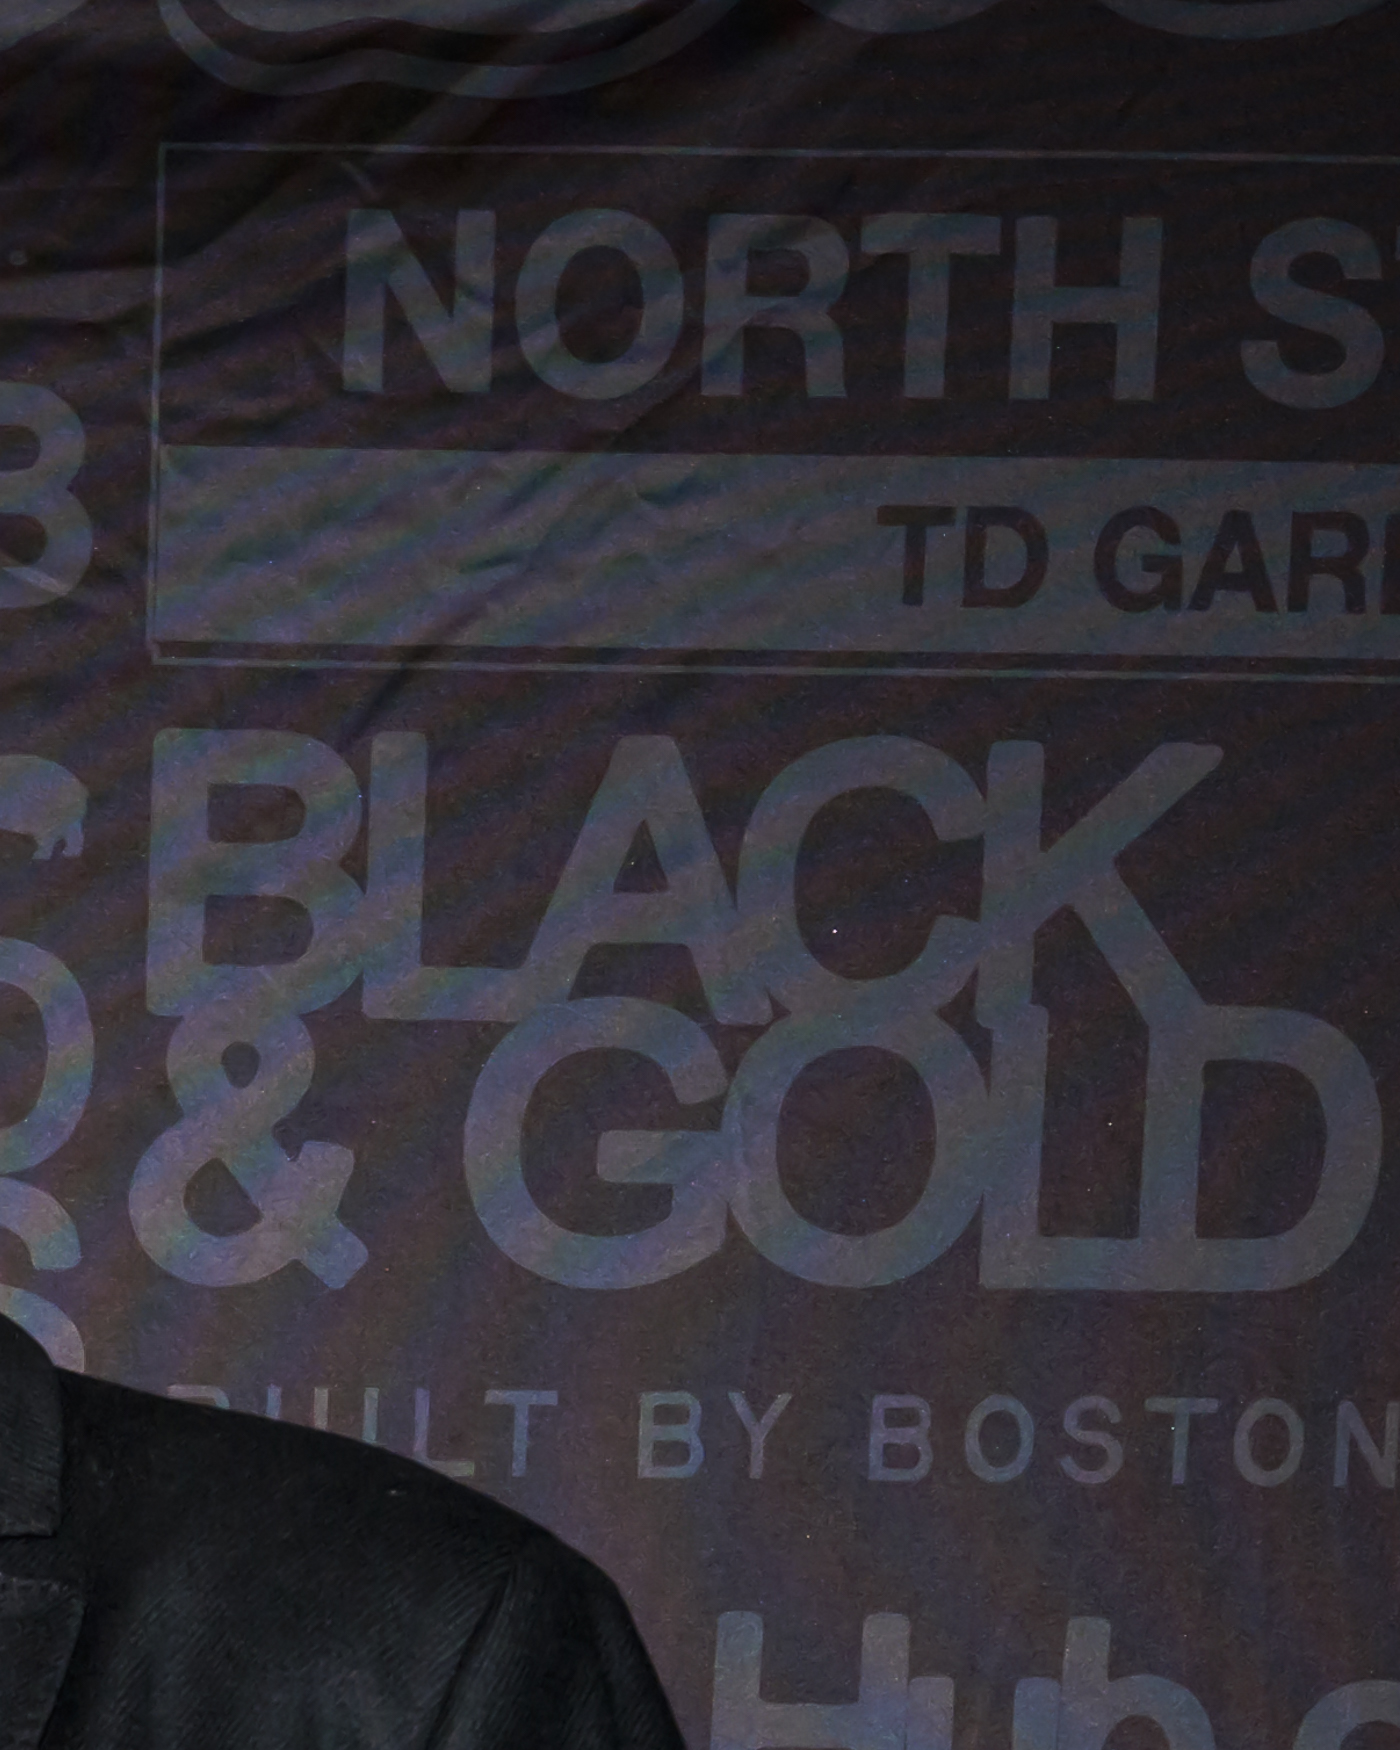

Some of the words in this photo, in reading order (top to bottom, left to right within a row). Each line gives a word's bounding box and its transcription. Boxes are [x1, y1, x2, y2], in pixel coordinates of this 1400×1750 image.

[341, 207, 1163, 401] NORTH
[876, 504, 1049, 611] TD
[146, 726, 1224, 1026] BLACK
[463, 995, 1384, 1293] GOLD
[637, 1390, 793, 1480] BY
[867, 1394, 1400, 1490] BOSTON
